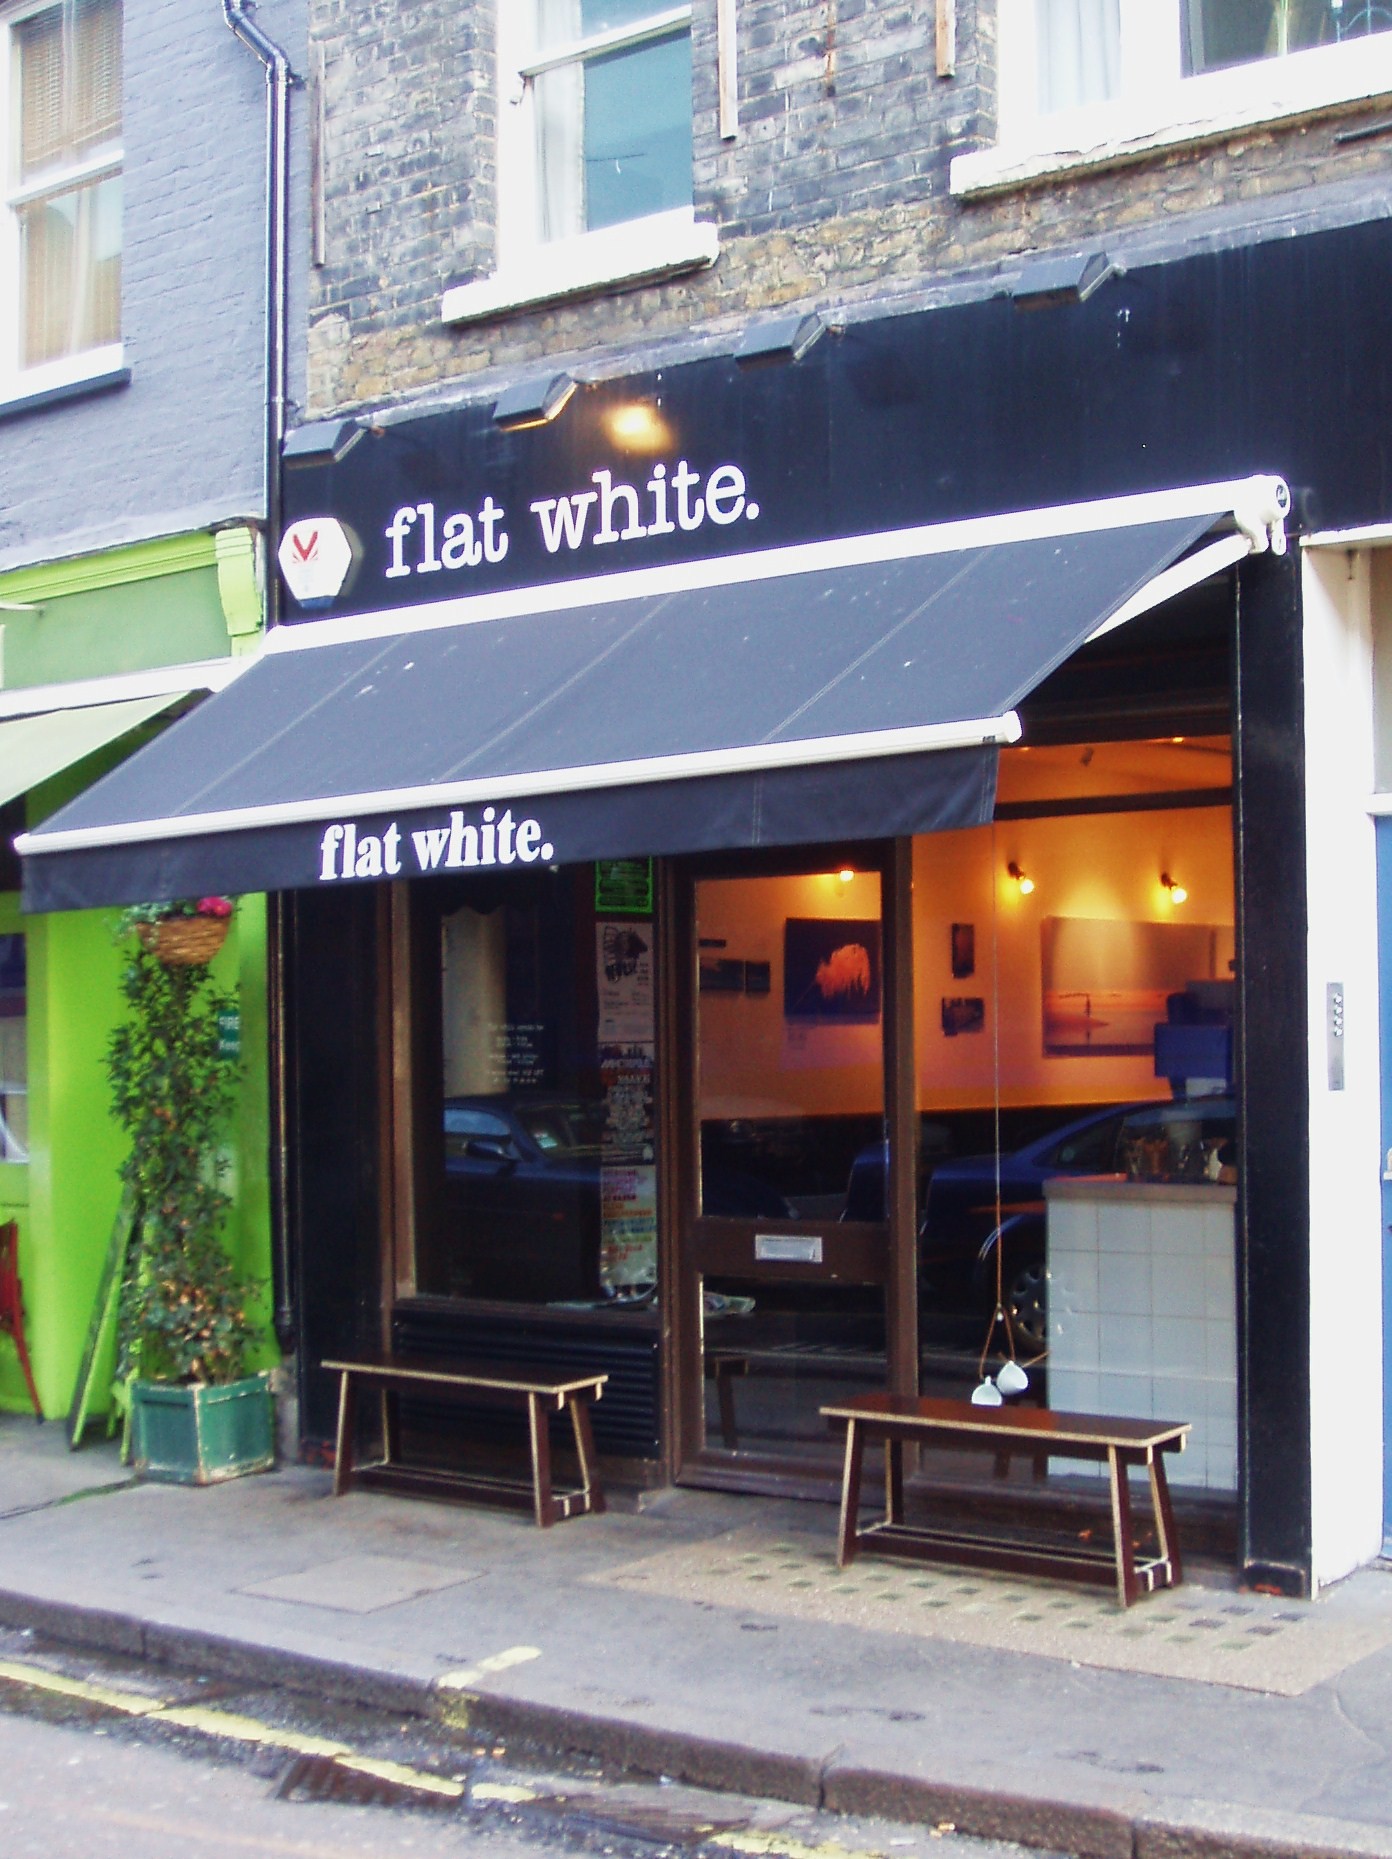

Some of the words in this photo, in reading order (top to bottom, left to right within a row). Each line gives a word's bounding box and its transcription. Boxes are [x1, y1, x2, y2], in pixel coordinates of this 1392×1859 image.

[384, 497, 510, 580] flat
[529, 460, 761, 554] white.
[319, 821, 402, 881] flat
[411, 806, 555, 871] white.
